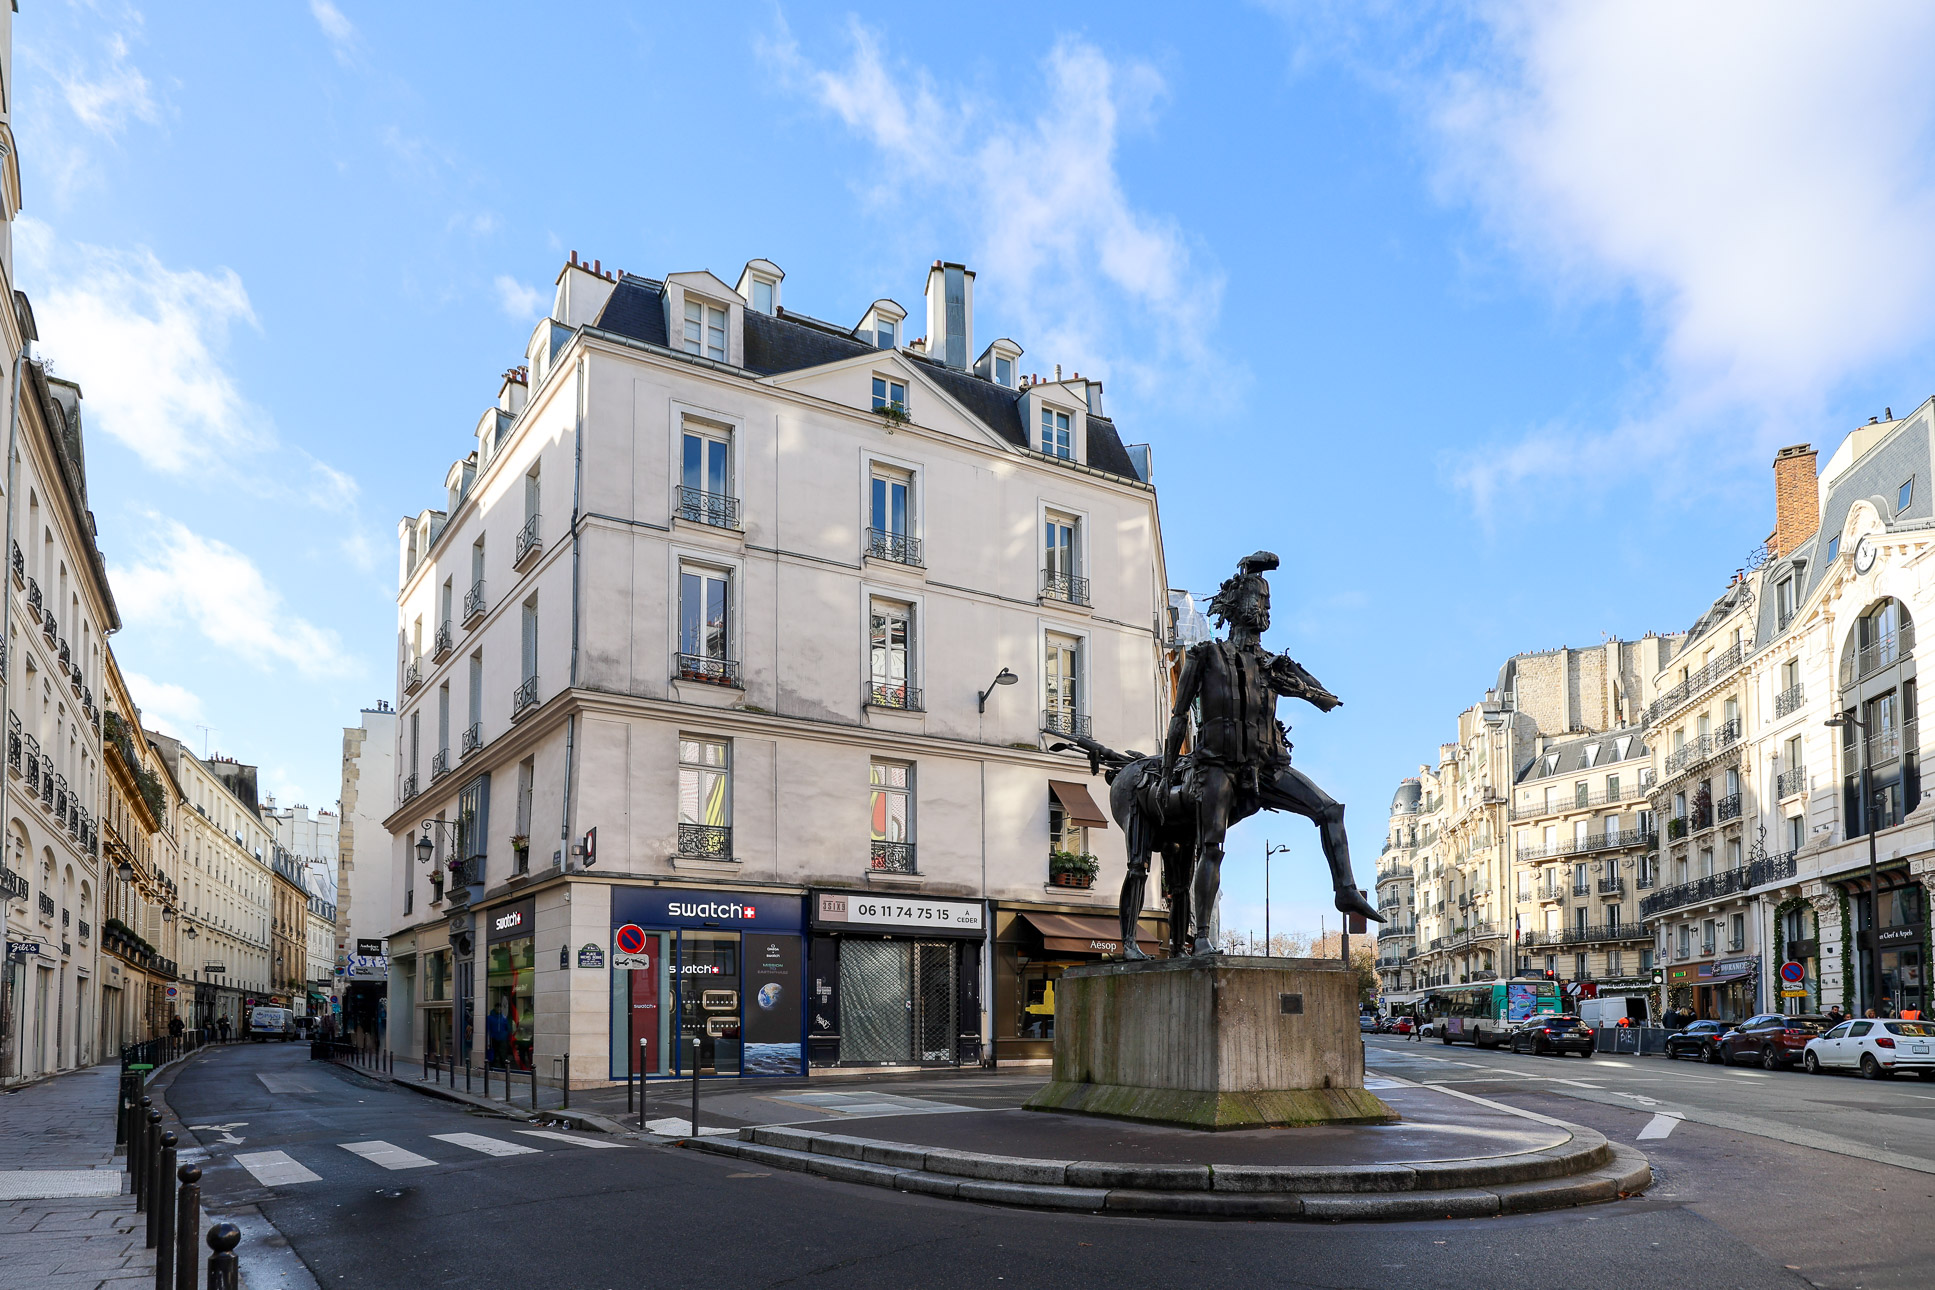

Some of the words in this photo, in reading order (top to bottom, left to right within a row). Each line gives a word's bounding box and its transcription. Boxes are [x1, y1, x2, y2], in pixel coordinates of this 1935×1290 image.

[668, 902, 743, 919] swatch
[858, 904, 877, 916] 06
[880, 905, 892, 917] 11
[896, 906, 913, 918] 74
[917, 907, 933, 919] 75
[936, 908, 950, 920] 15
[496, 911, 518, 931] swatch
